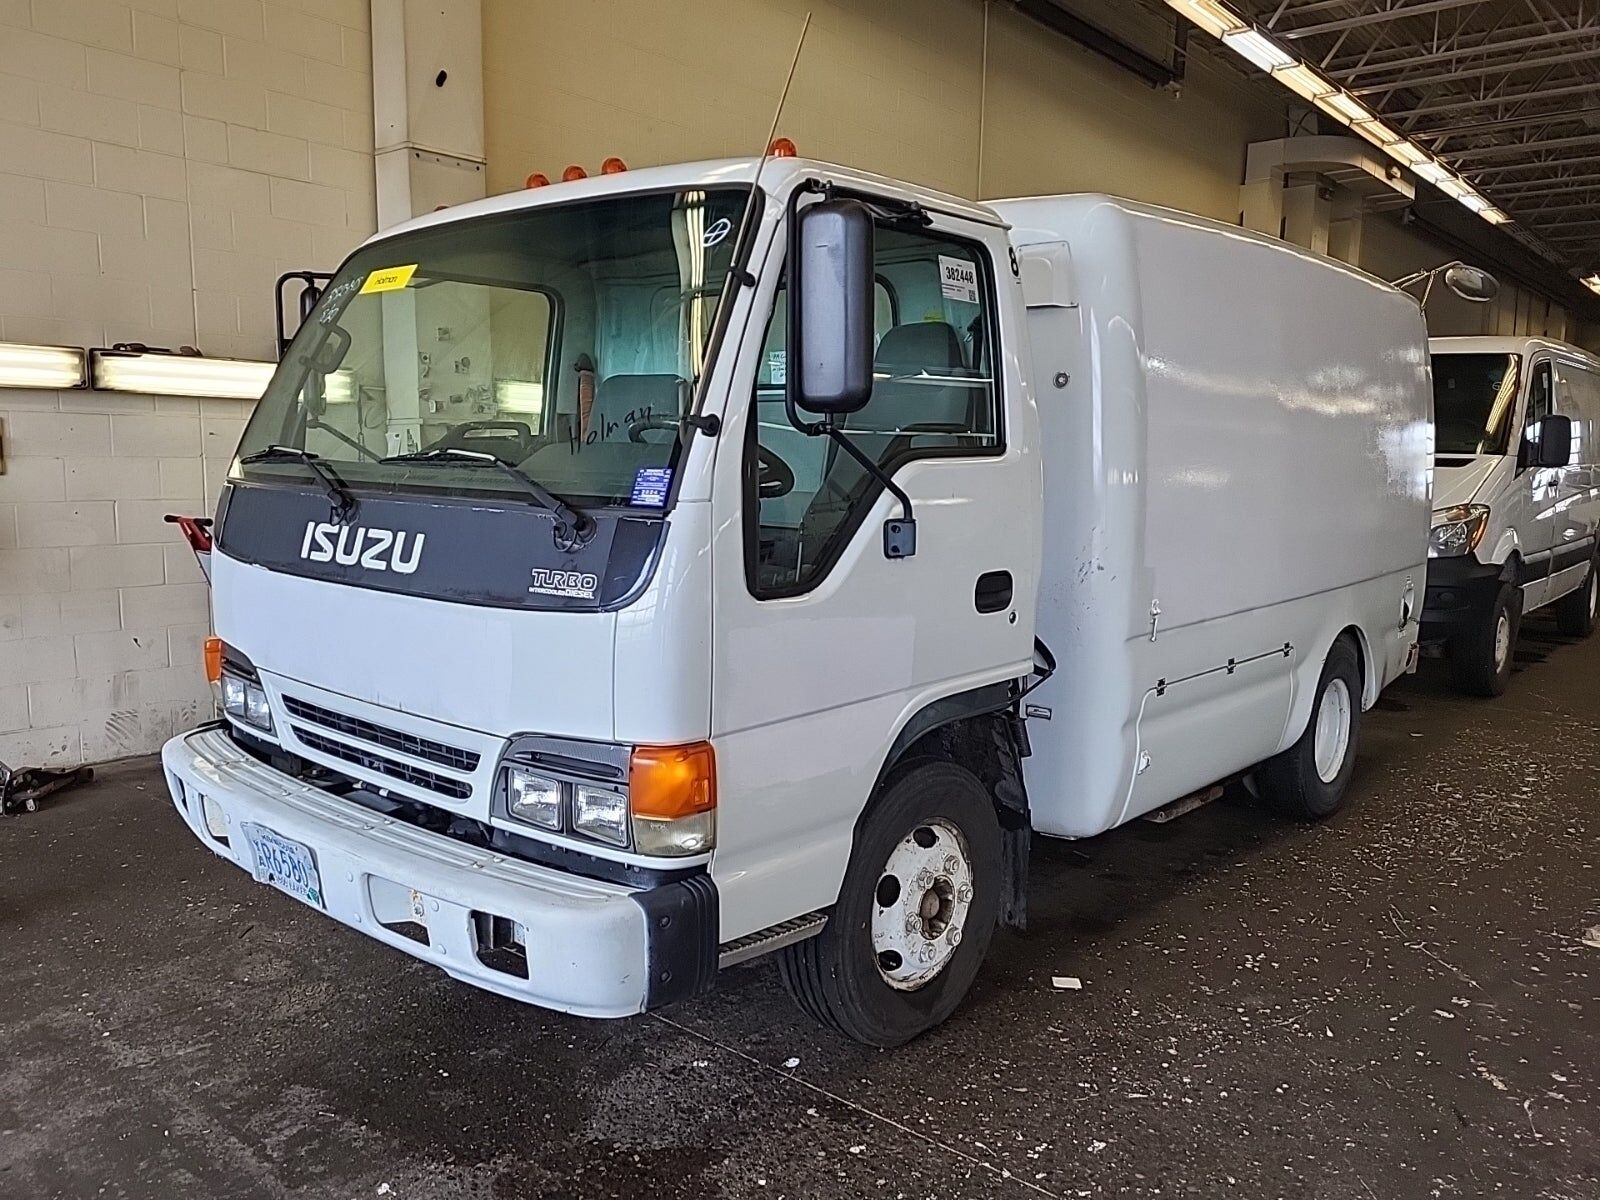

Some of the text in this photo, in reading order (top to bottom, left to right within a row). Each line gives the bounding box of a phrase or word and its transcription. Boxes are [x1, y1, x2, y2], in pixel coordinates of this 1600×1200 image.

[945, 266, 974, 284] 382448
[568, 406, 652, 456] Holman
[300, 521, 426, 574] ISUZU
[531, 568, 597, 591] TURBO
[565, 588, 595, 599] DIESEL
